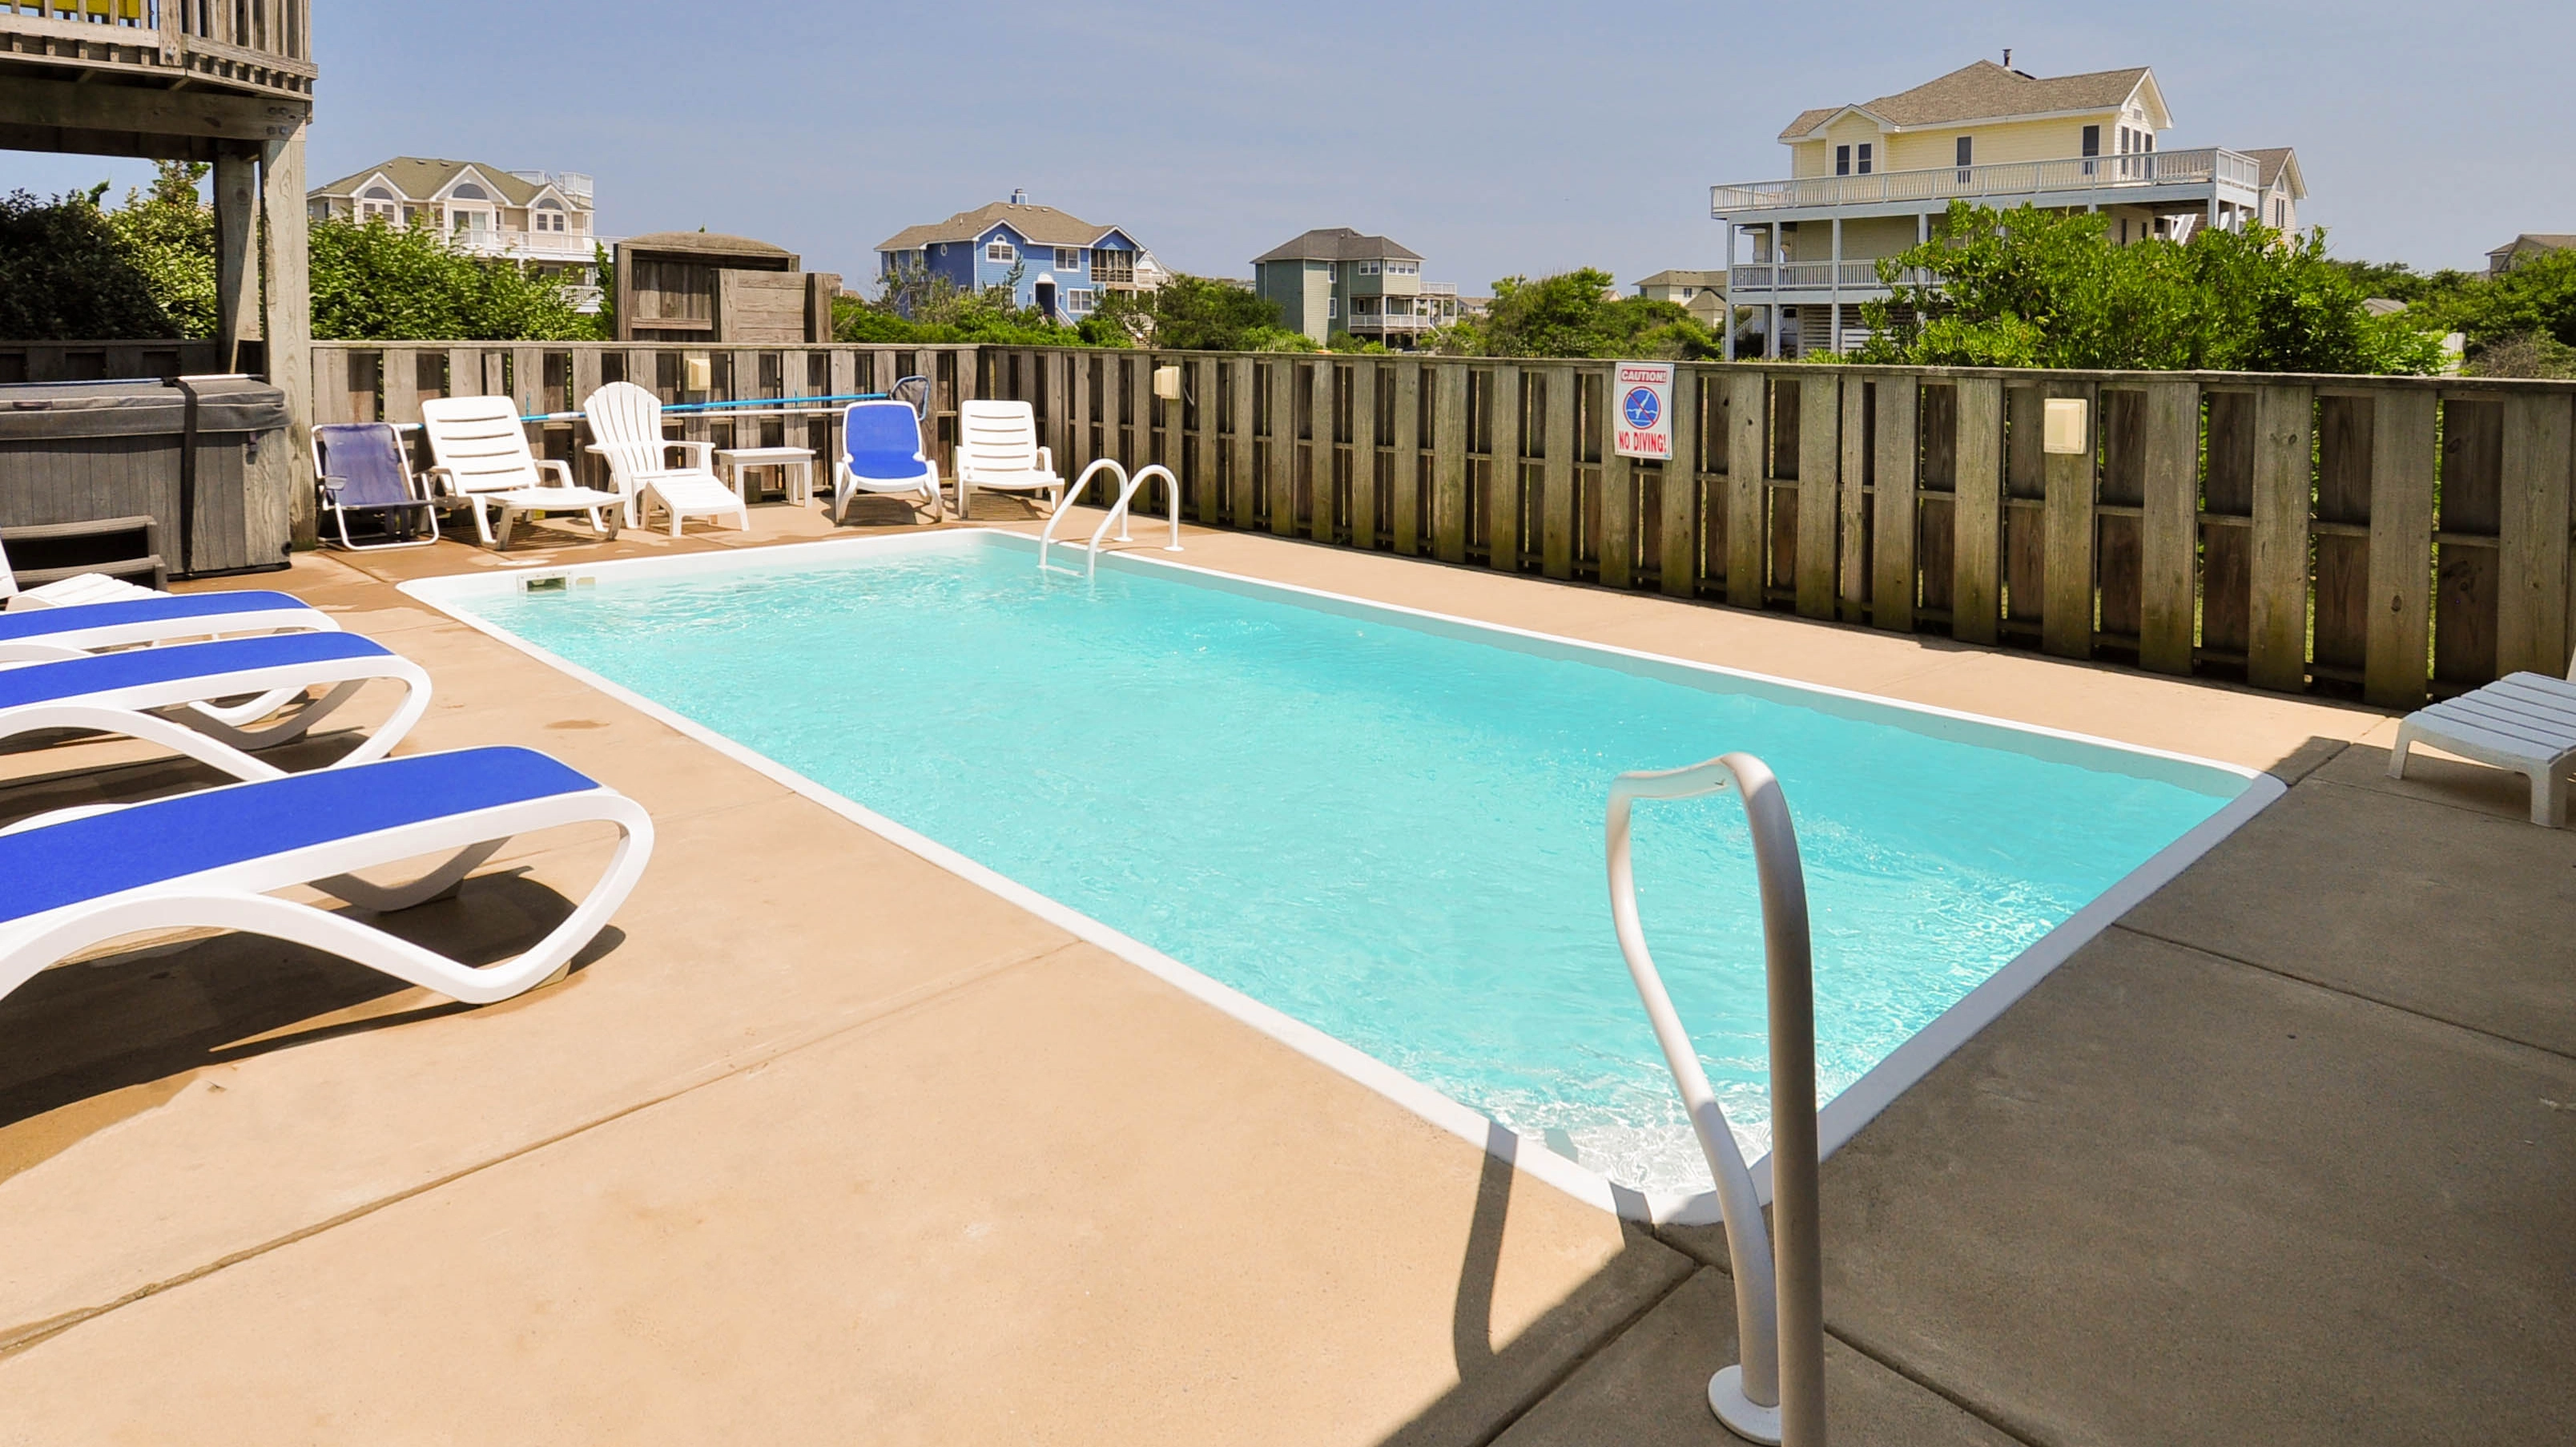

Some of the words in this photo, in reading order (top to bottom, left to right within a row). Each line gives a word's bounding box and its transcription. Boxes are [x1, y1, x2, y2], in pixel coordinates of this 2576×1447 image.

[1621, 370, 1667, 382] CAUTION!
[1618, 430, 1630, 449] NO
[1634, 432, 1667, 453] DIVING!
